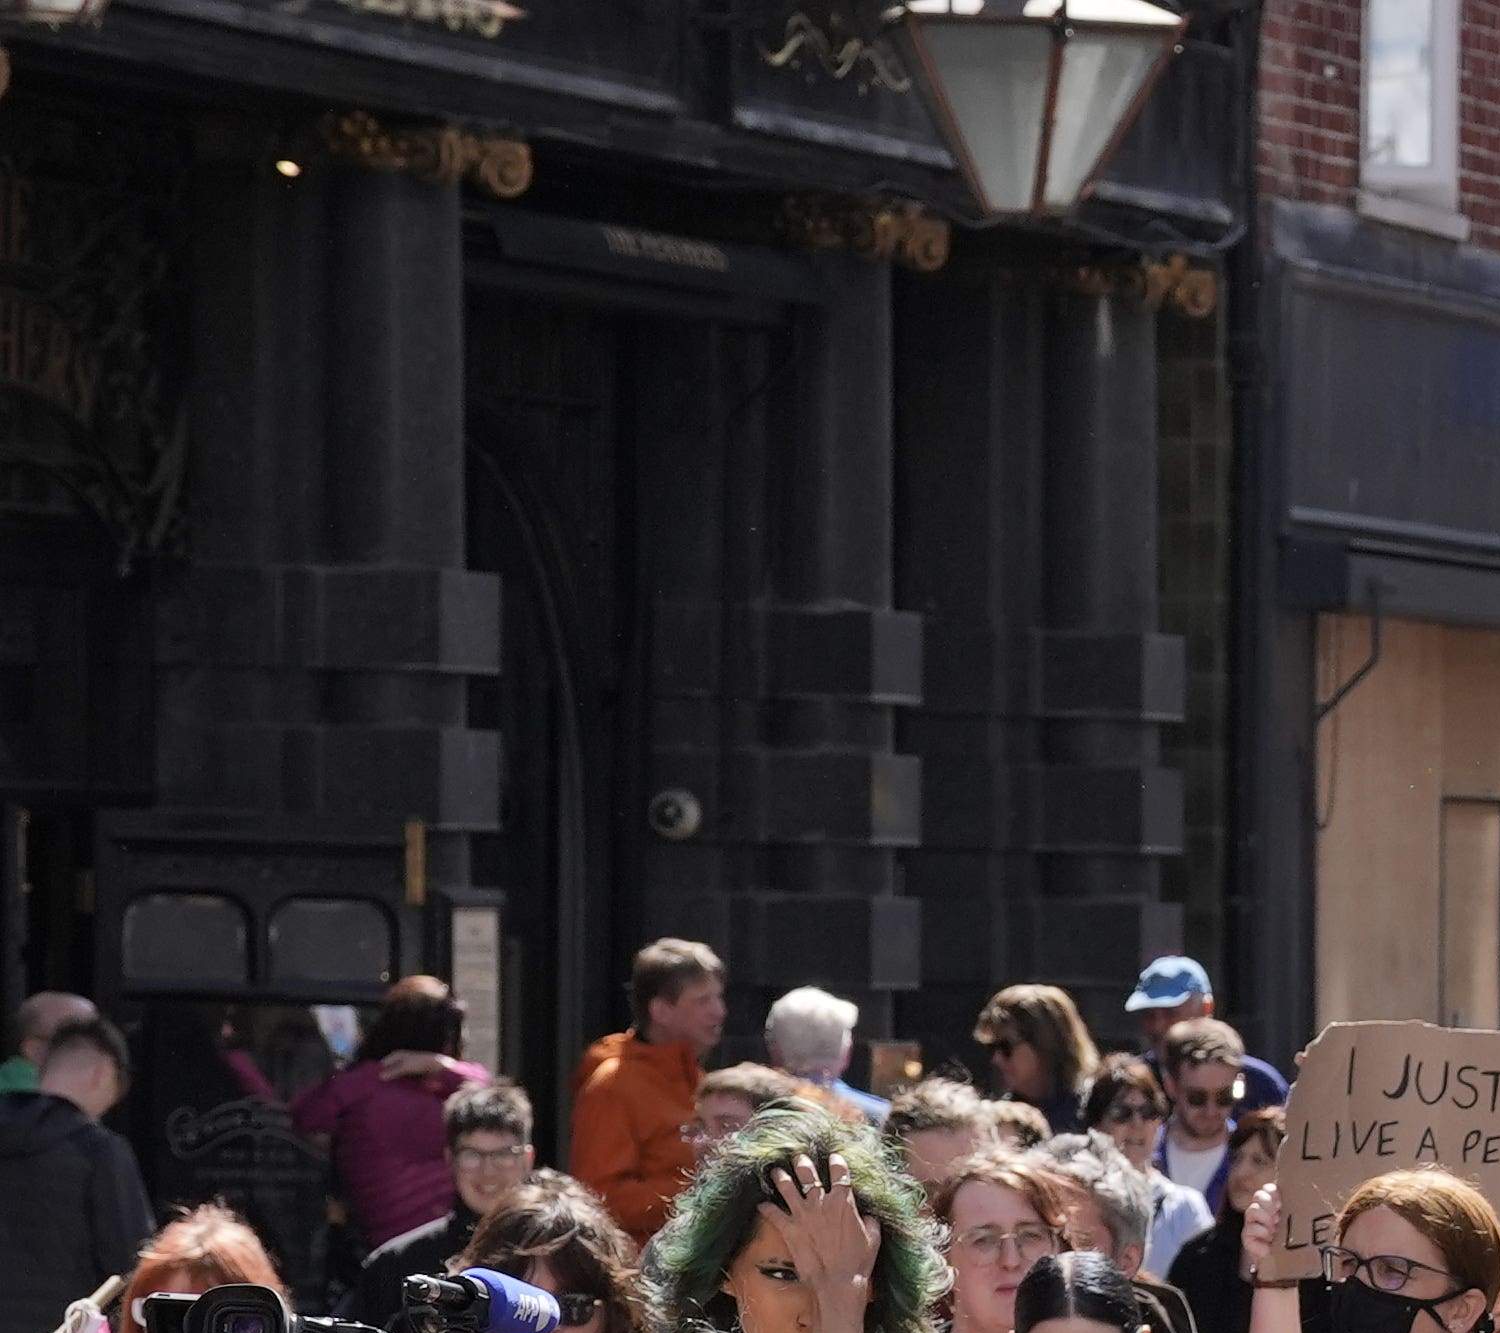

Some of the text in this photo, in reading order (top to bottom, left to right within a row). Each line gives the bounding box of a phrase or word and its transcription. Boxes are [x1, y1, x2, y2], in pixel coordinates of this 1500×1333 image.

[1346, 1046, 1356, 1096] I
[1300, 1120, 1400, 1162] LIVE
[1414, 1125, 1439, 1161] A
[513, 1293, 540, 1325] AFP
